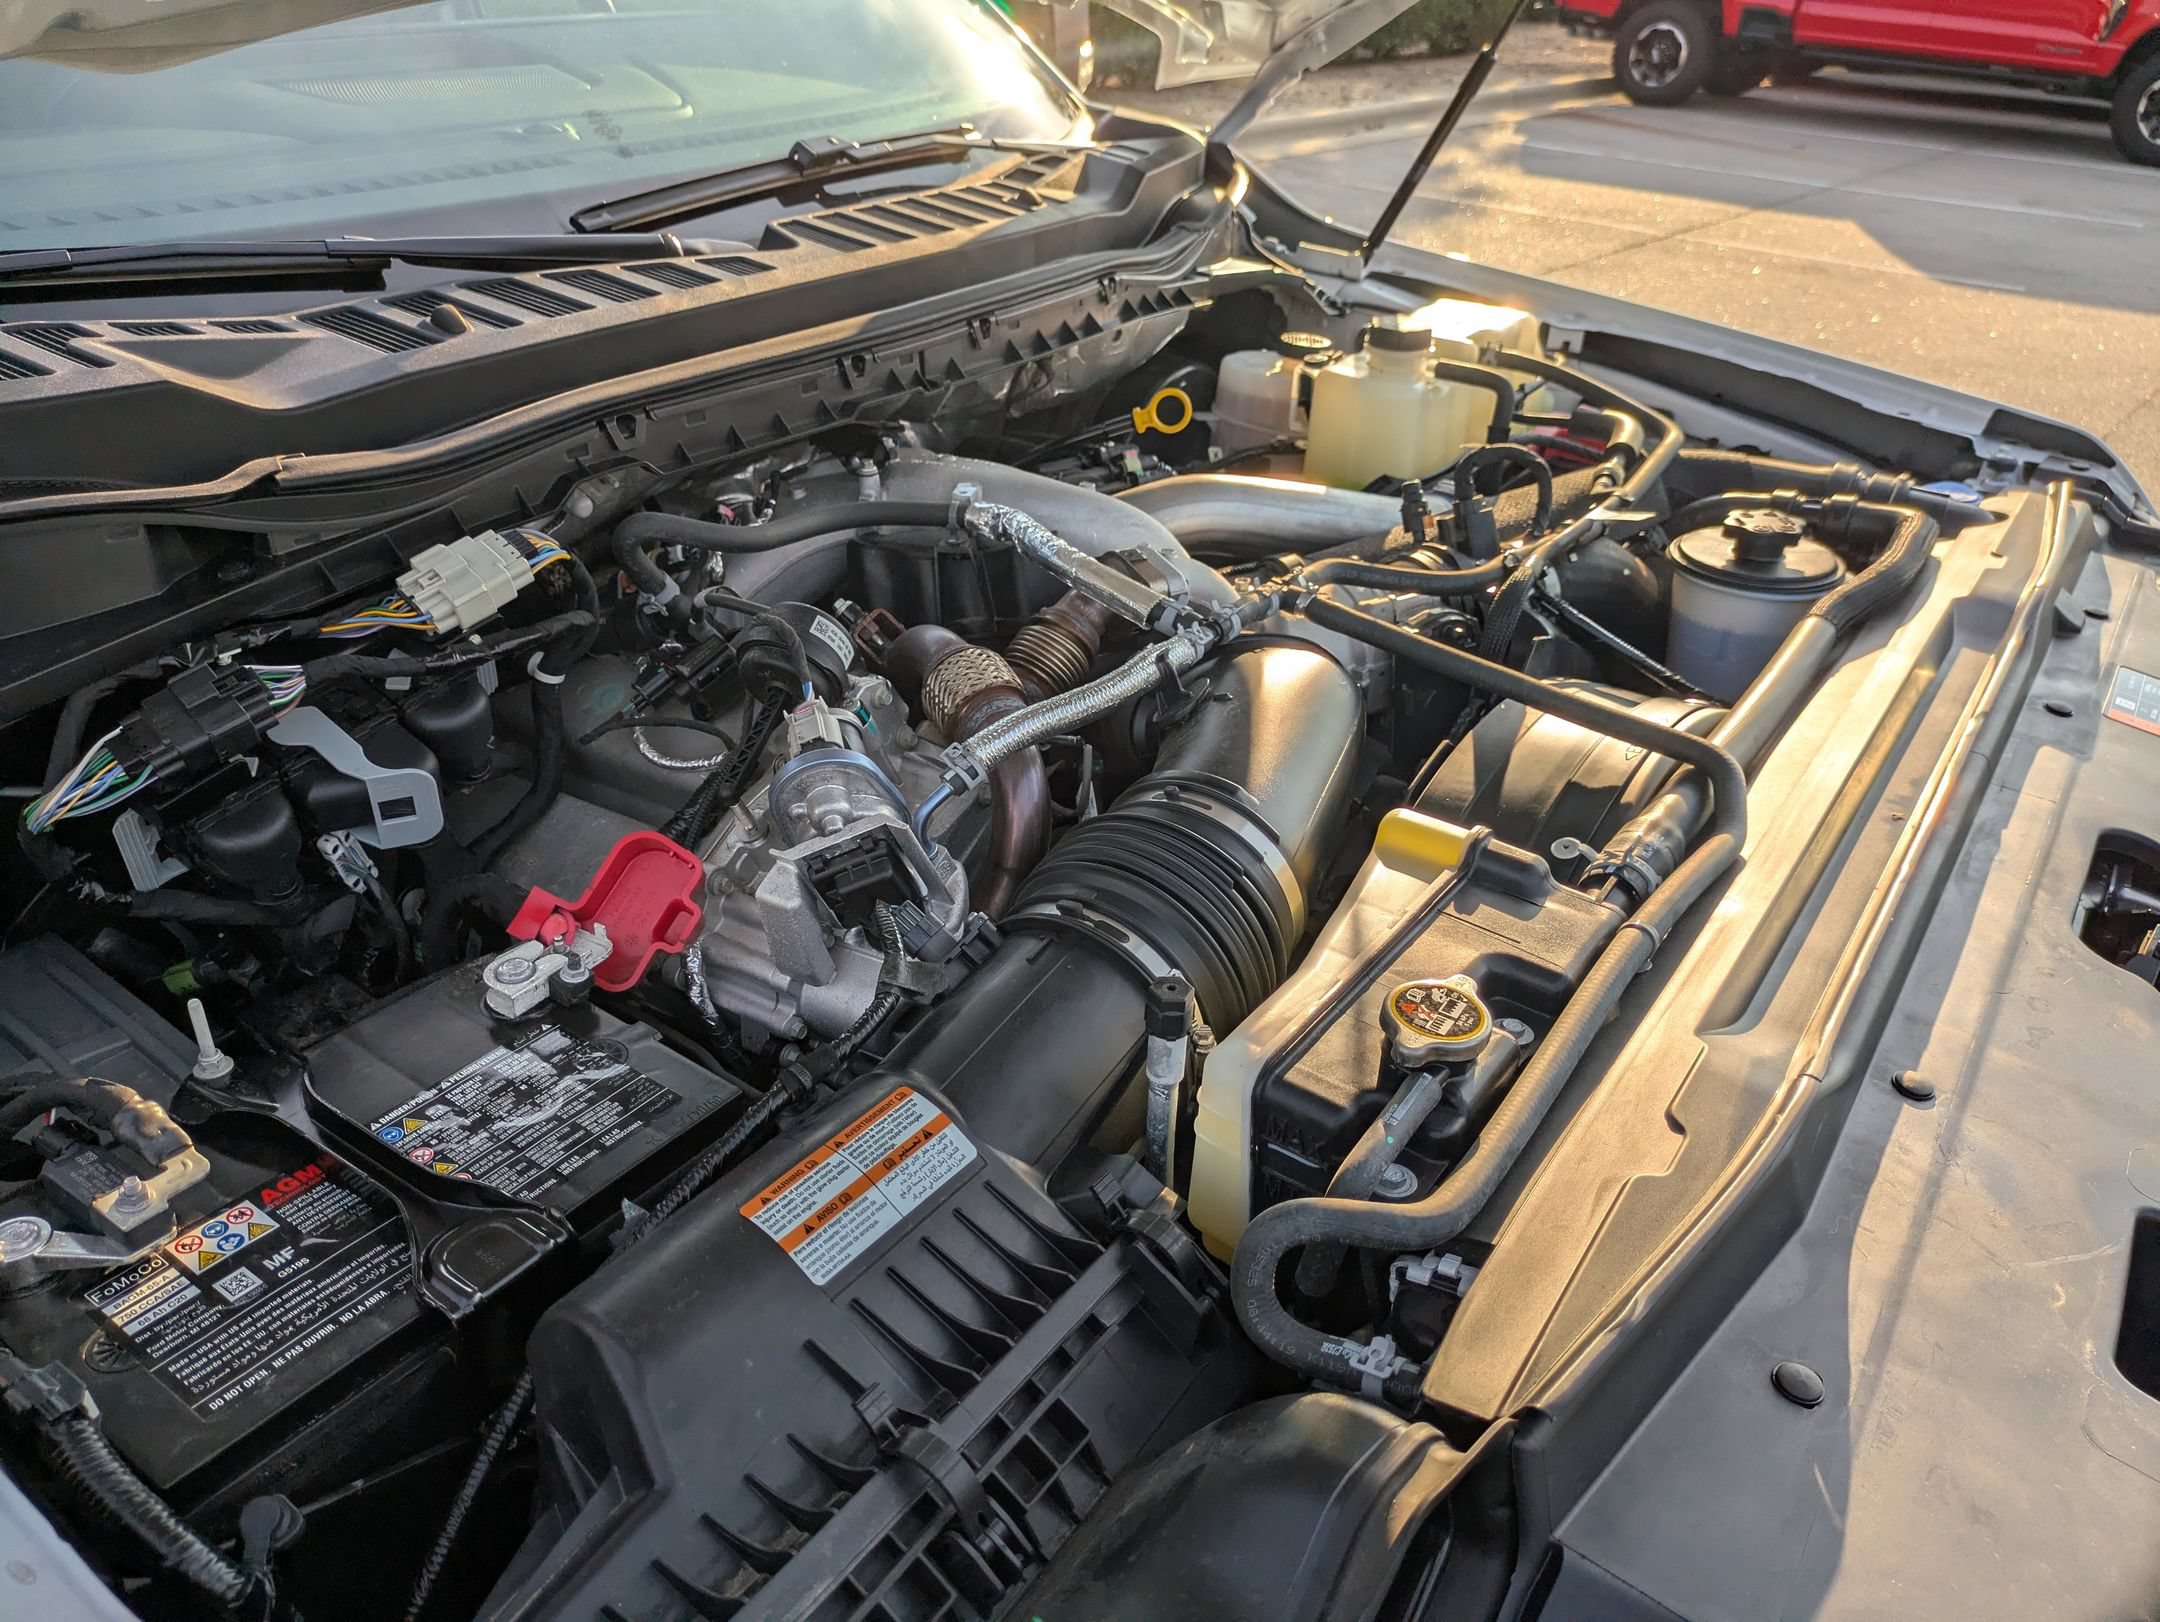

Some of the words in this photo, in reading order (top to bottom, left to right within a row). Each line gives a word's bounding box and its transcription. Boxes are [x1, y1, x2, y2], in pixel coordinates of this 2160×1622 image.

[378, 1087, 439, 1124] DANGER/POISON
[843, 1098, 895, 1138] AVERTISSEMENT
[598, 1134, 611, 1143] LEA
[555, 1162, 570, 1172] LIRE
[567, 1154, 580, 1163] LES
[261, 1164, 322, 1205] AGM
[768, 1167, 805, 1196] WARNING
[814, 1201, 839, 1222] AVISO
[261, 1245, 298, 1271] MF
[276, 1255, 311, 1279] G519S
[90, 1257, 163, 1302] FoMoCo
[112, 1273, 170, 1309] BAGM-65-A
[117, 1308, 138, 1322] 750
[137, 1279, 186, 1310] CCA/SAE
[136, 1315, 152, 1327] 68
[150, 1305, 167, 1318] Ah
[166, 1292, 188, 1308] C20
[145, 1338, 165, 1353] Ford
[163, 1324, 188, 1341] Motor
[167, 1356, 190, 1372] Made
[196, 1341, 214, 1354] USA
[211, 1331, 229, 1344] with
[227, 1324, 239, 1334] US
[237, 1316, 253, 1327] and
[207, 1397, 225, 1410] DO
[222, 1384, 244, 1401] NOT
[241, 1365, 272, 1388] OPEN.
[270, 1355, 287, 1368] NE
[283, 1343, 305, 1359] PAS
[301, 1320, 340, 1348] OUVRIR.
[338, 1310, 354, 1323] NO
[351, 1302, 366, 1315] LA
[361, 1286, 390, 1308] ABRA.
